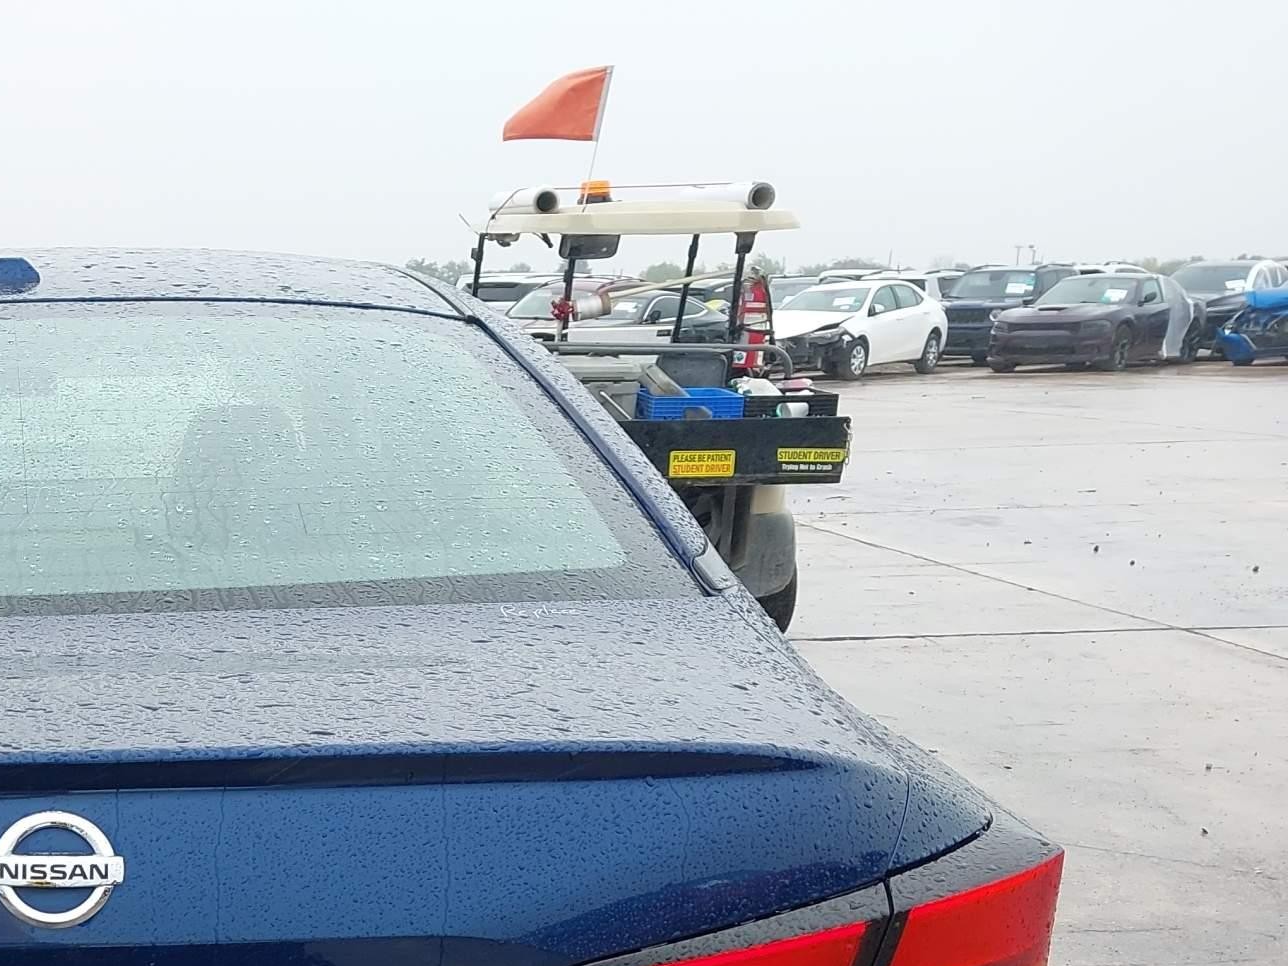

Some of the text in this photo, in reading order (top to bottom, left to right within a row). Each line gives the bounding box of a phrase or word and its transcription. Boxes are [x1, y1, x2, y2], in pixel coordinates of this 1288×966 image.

[673, 454, 732, 463] PLEASE BE PATIENT
[779, 451, 841, 461] STUDENT DRIVER
[673, 464, 730, 473] STUDENT DRIVER
[0, 863, 109, 880] NISSAN
